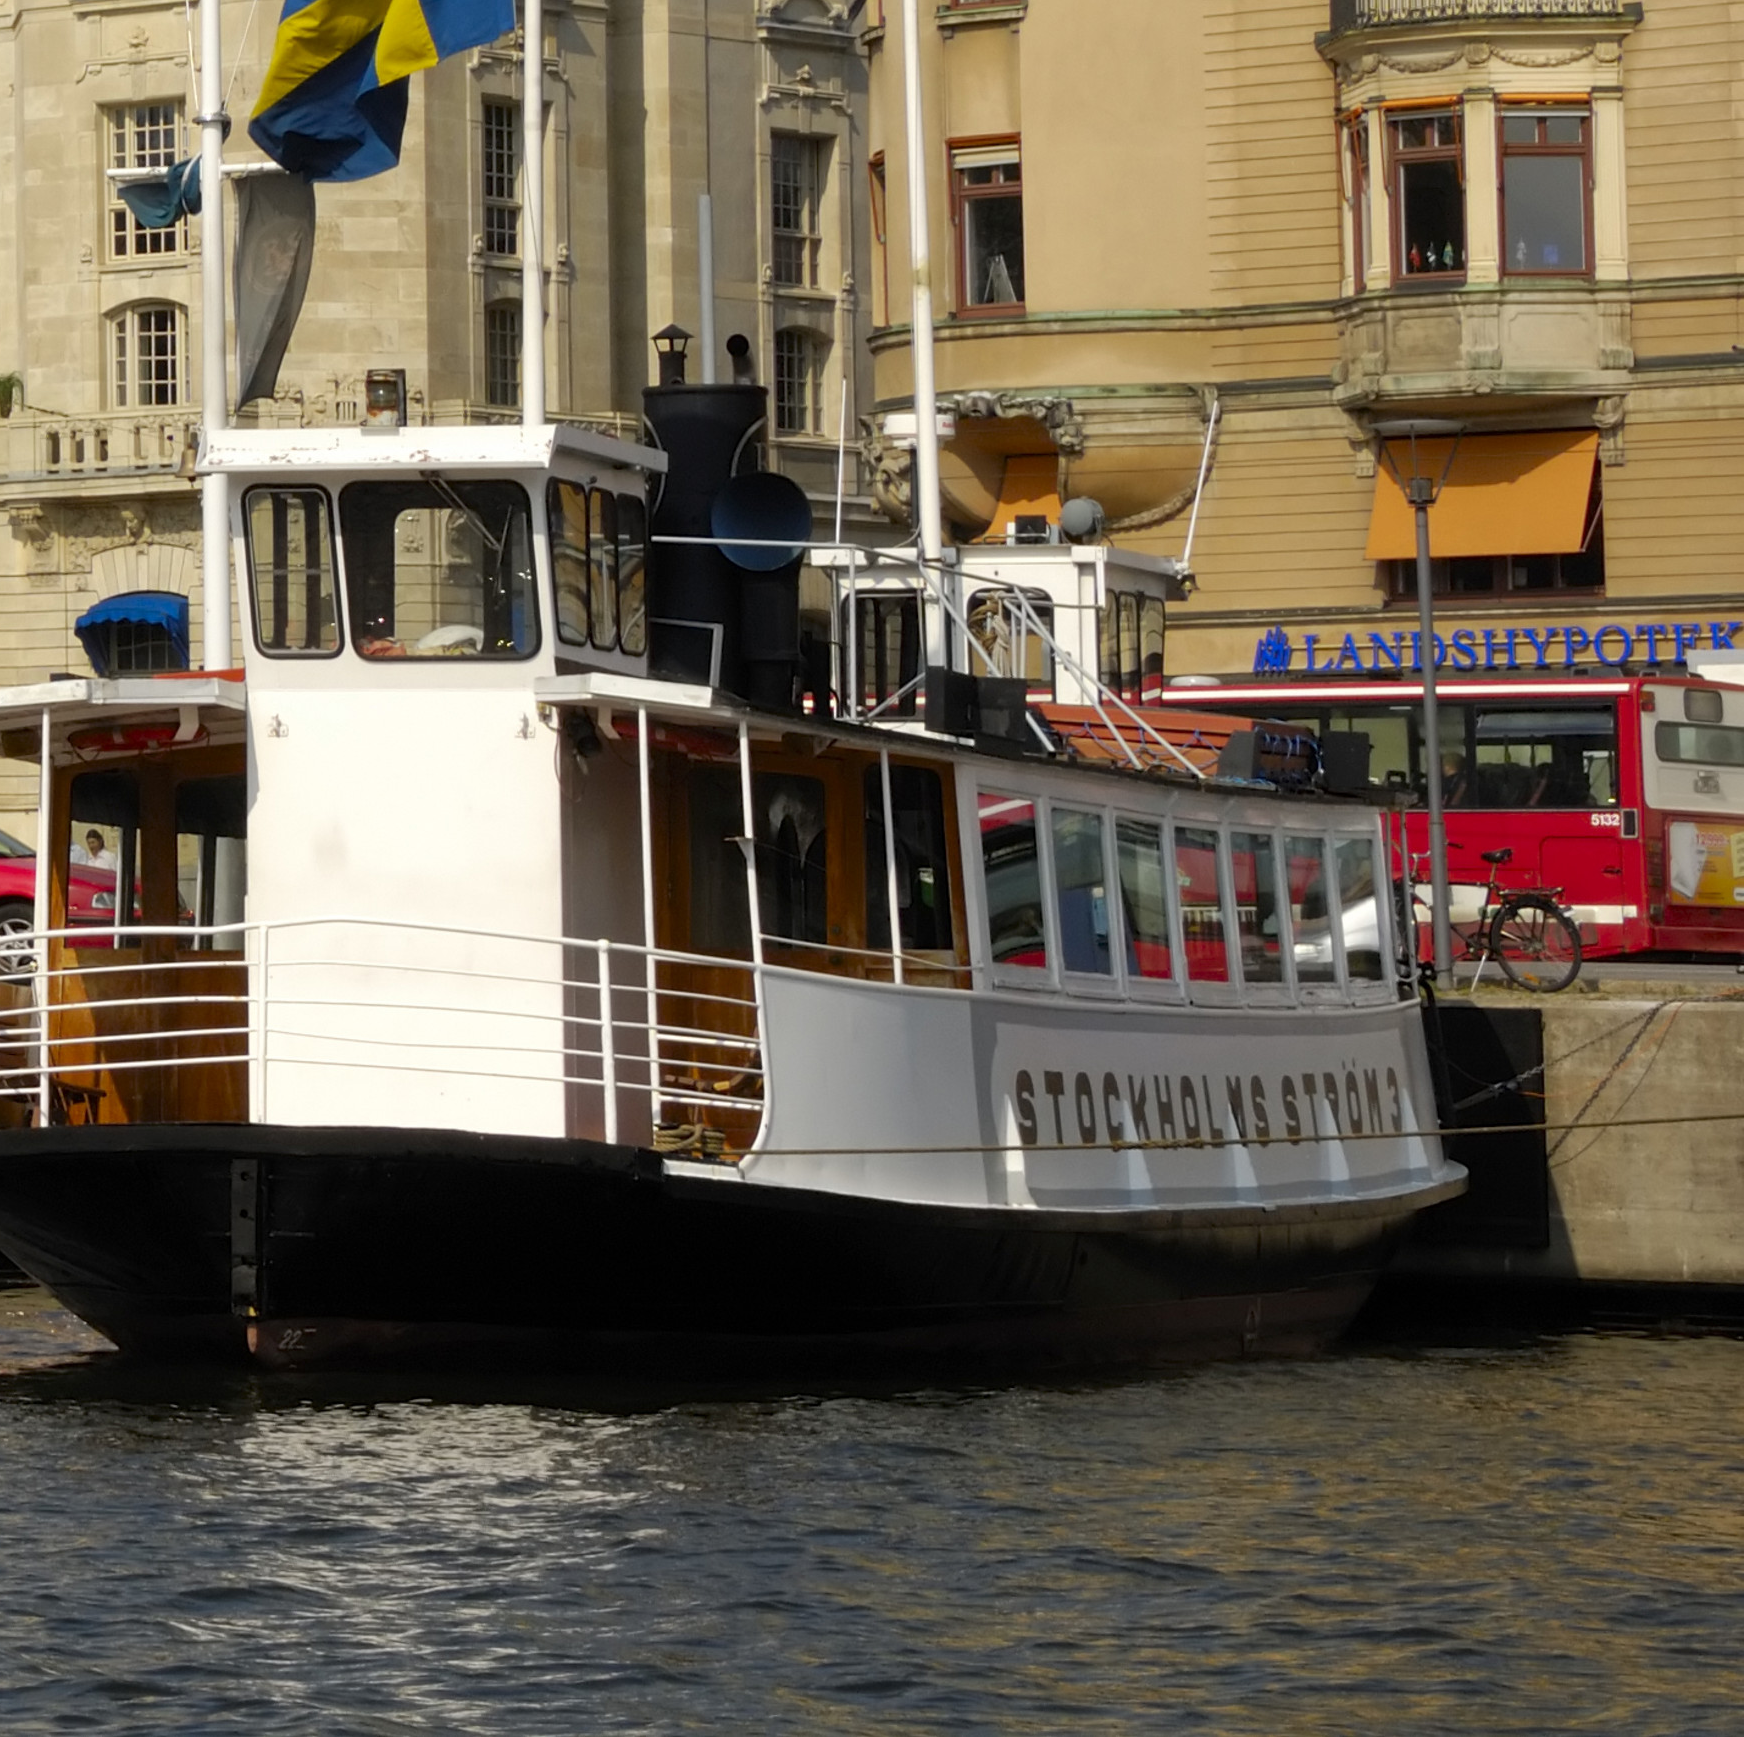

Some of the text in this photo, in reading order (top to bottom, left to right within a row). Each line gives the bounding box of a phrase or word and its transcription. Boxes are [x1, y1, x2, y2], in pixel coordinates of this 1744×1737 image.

[1303, 621, 1744, 673] LANDSHYPOTEK
[1591, 813, 1620, 826] 5132
[1015, 1059, 1403, 1148] STOCKHOLMS STRÖM 3
